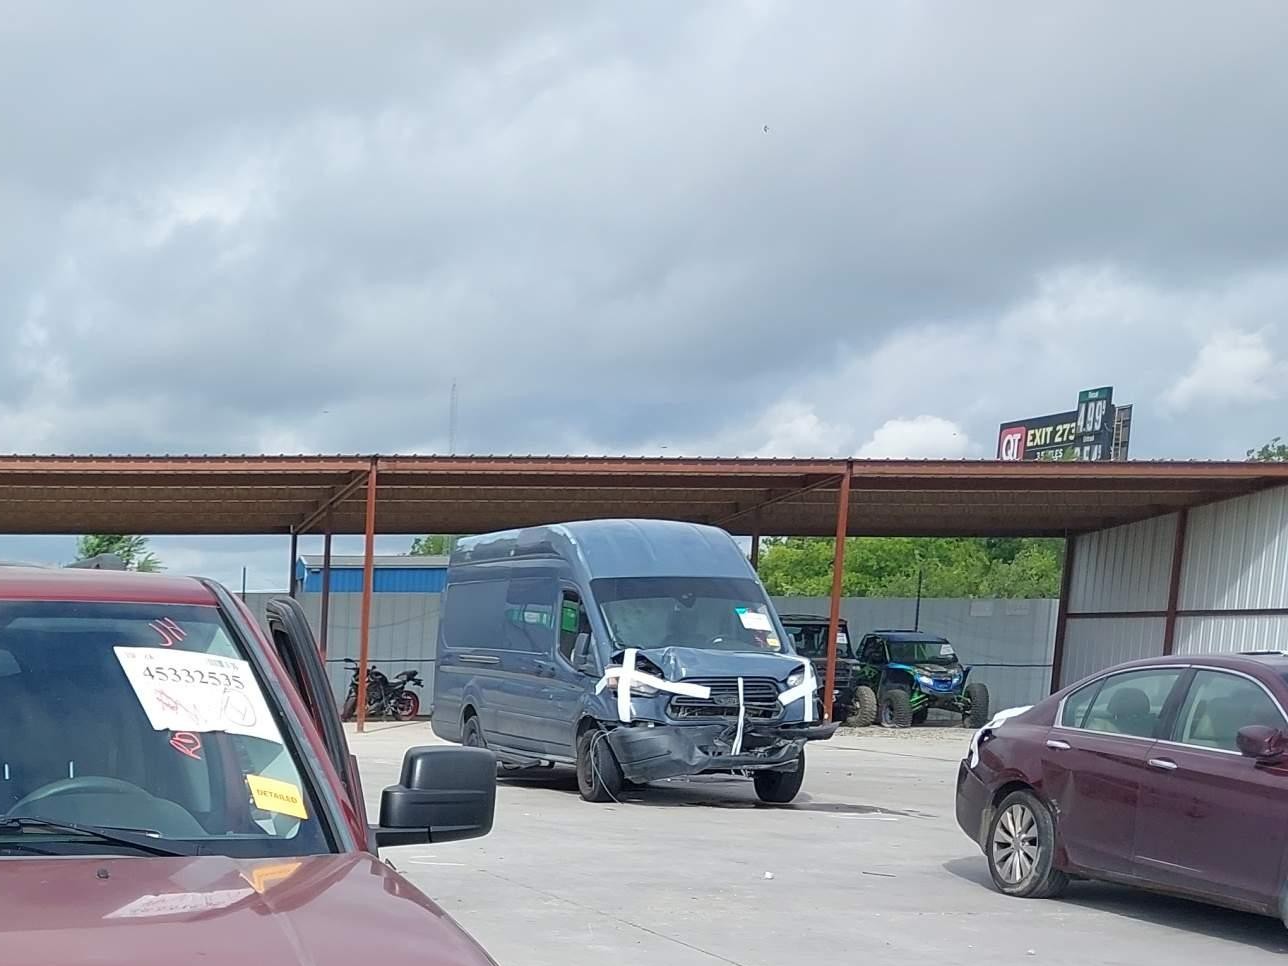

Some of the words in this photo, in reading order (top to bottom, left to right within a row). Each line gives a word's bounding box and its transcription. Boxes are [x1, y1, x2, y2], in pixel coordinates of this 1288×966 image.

[1002, 433, 1022, 460] QT
[1026, 427, 1054, 447] EXIT
[1054, 421, 1076, 443] 273
[143, 665, 245, 690] 45332535
